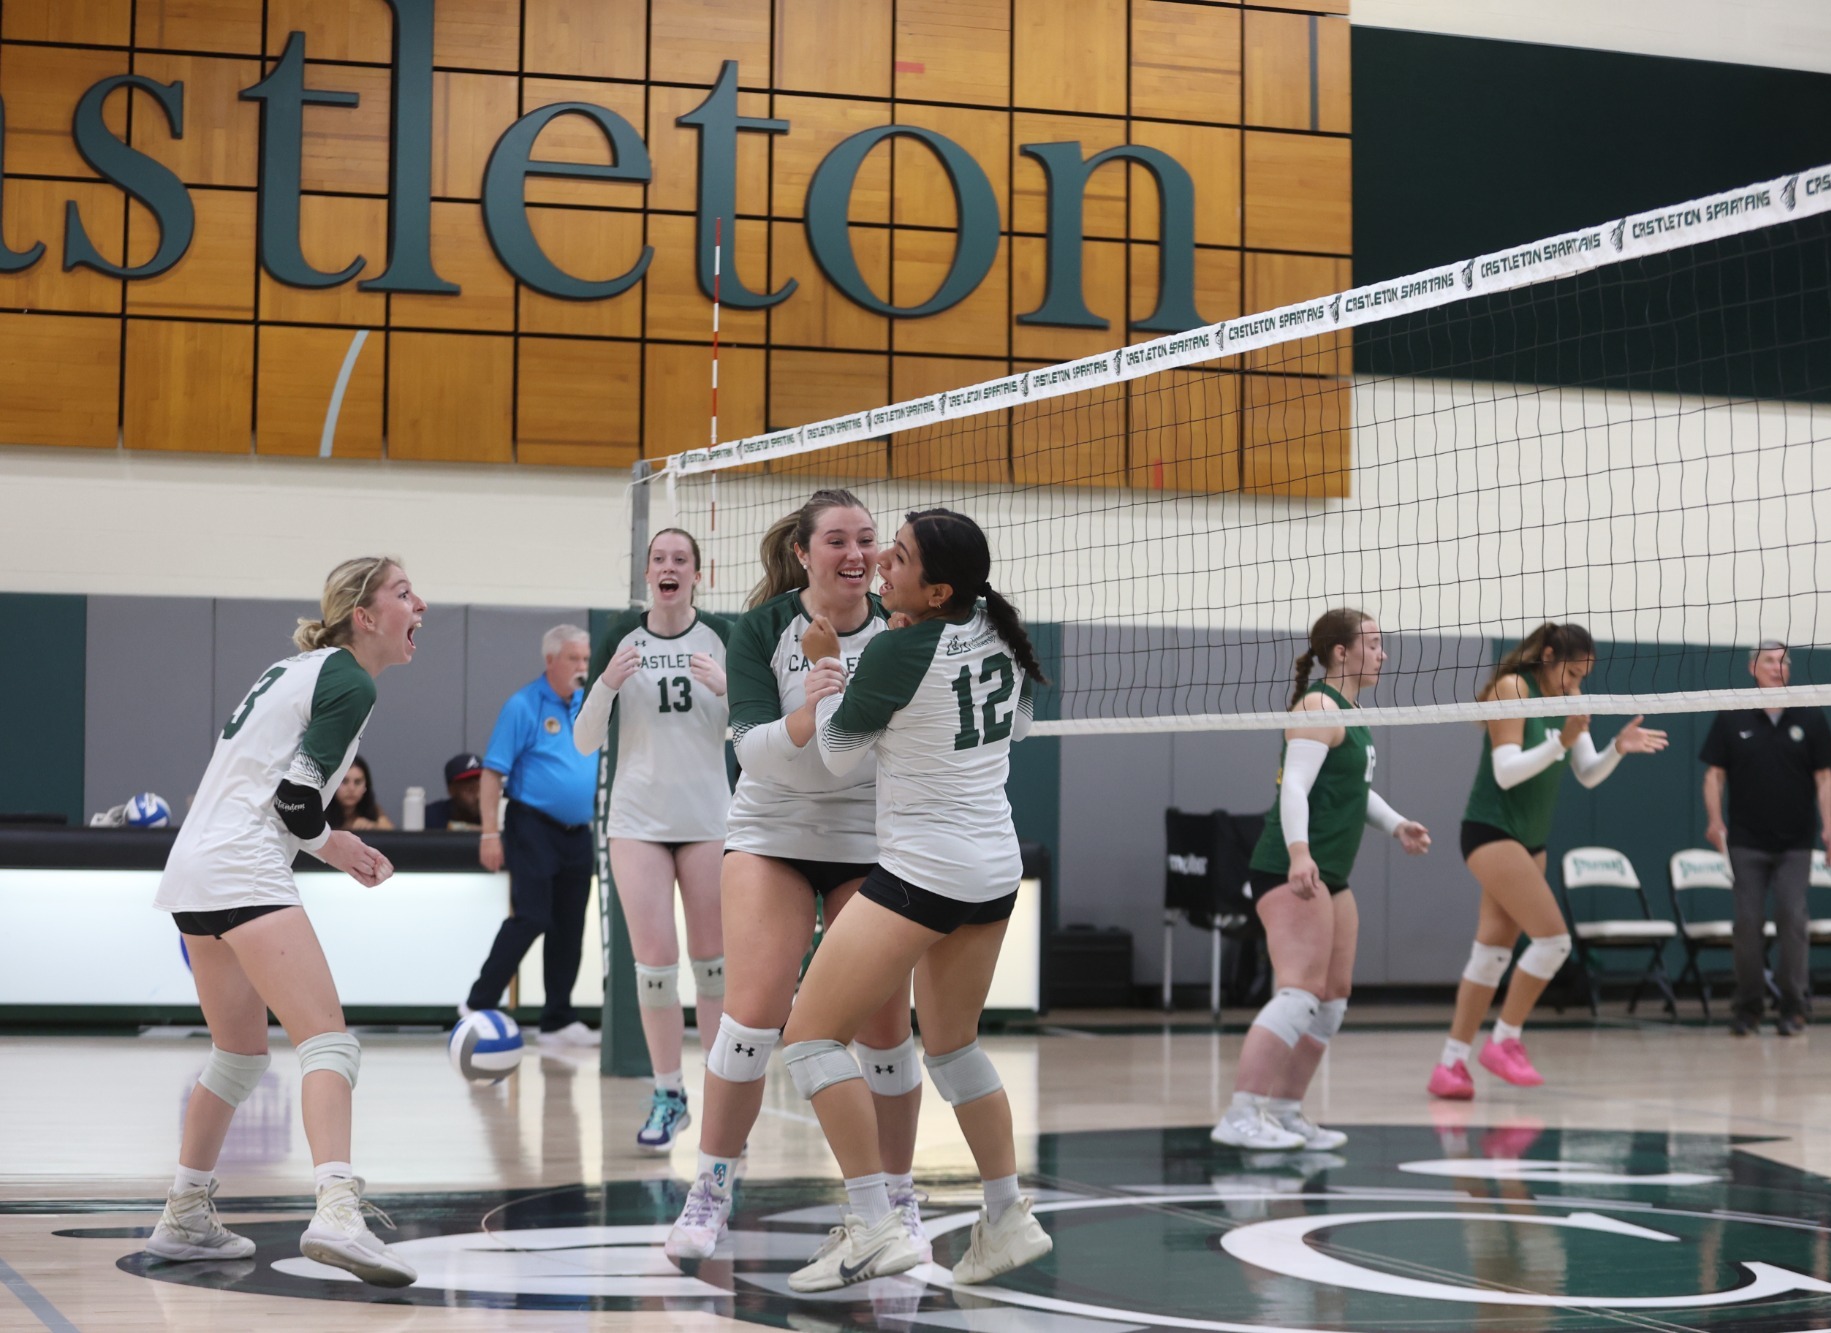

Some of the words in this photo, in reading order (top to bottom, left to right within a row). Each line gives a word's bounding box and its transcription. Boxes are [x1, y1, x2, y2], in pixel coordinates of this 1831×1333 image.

[1632, 208, 1701, 239] CASTLETON
[1706, 190, 1770, 222] SPARTANS
[1481, 247, 1541, 279] CASTLETON
[1543, 232, 1601, 260] SPARTANS
[1345, 286, 1398, 313] CASTLETON
[1401, 272, 1454, 300] SPARTANS
[1229, 317, 1276, 341] CASTLETON
[1279, 305, 1324, 330] SPARTANS
[1125, 344, 1167, 367] CASTLETON
[1169, 334, 1209, 356] SPARTANS
[1033, 370, 1070, 388] CASTLETON
[1072, 359, 1108, 381] SPARTANS
[948, 389, 982, 408] CASTLETON
[983, 380, 1018, 399] SPARTANS
[222, 667, 288, 740] 3
[658, 676, 692, 713] 13
[951, 652, 1015, 751] 12
